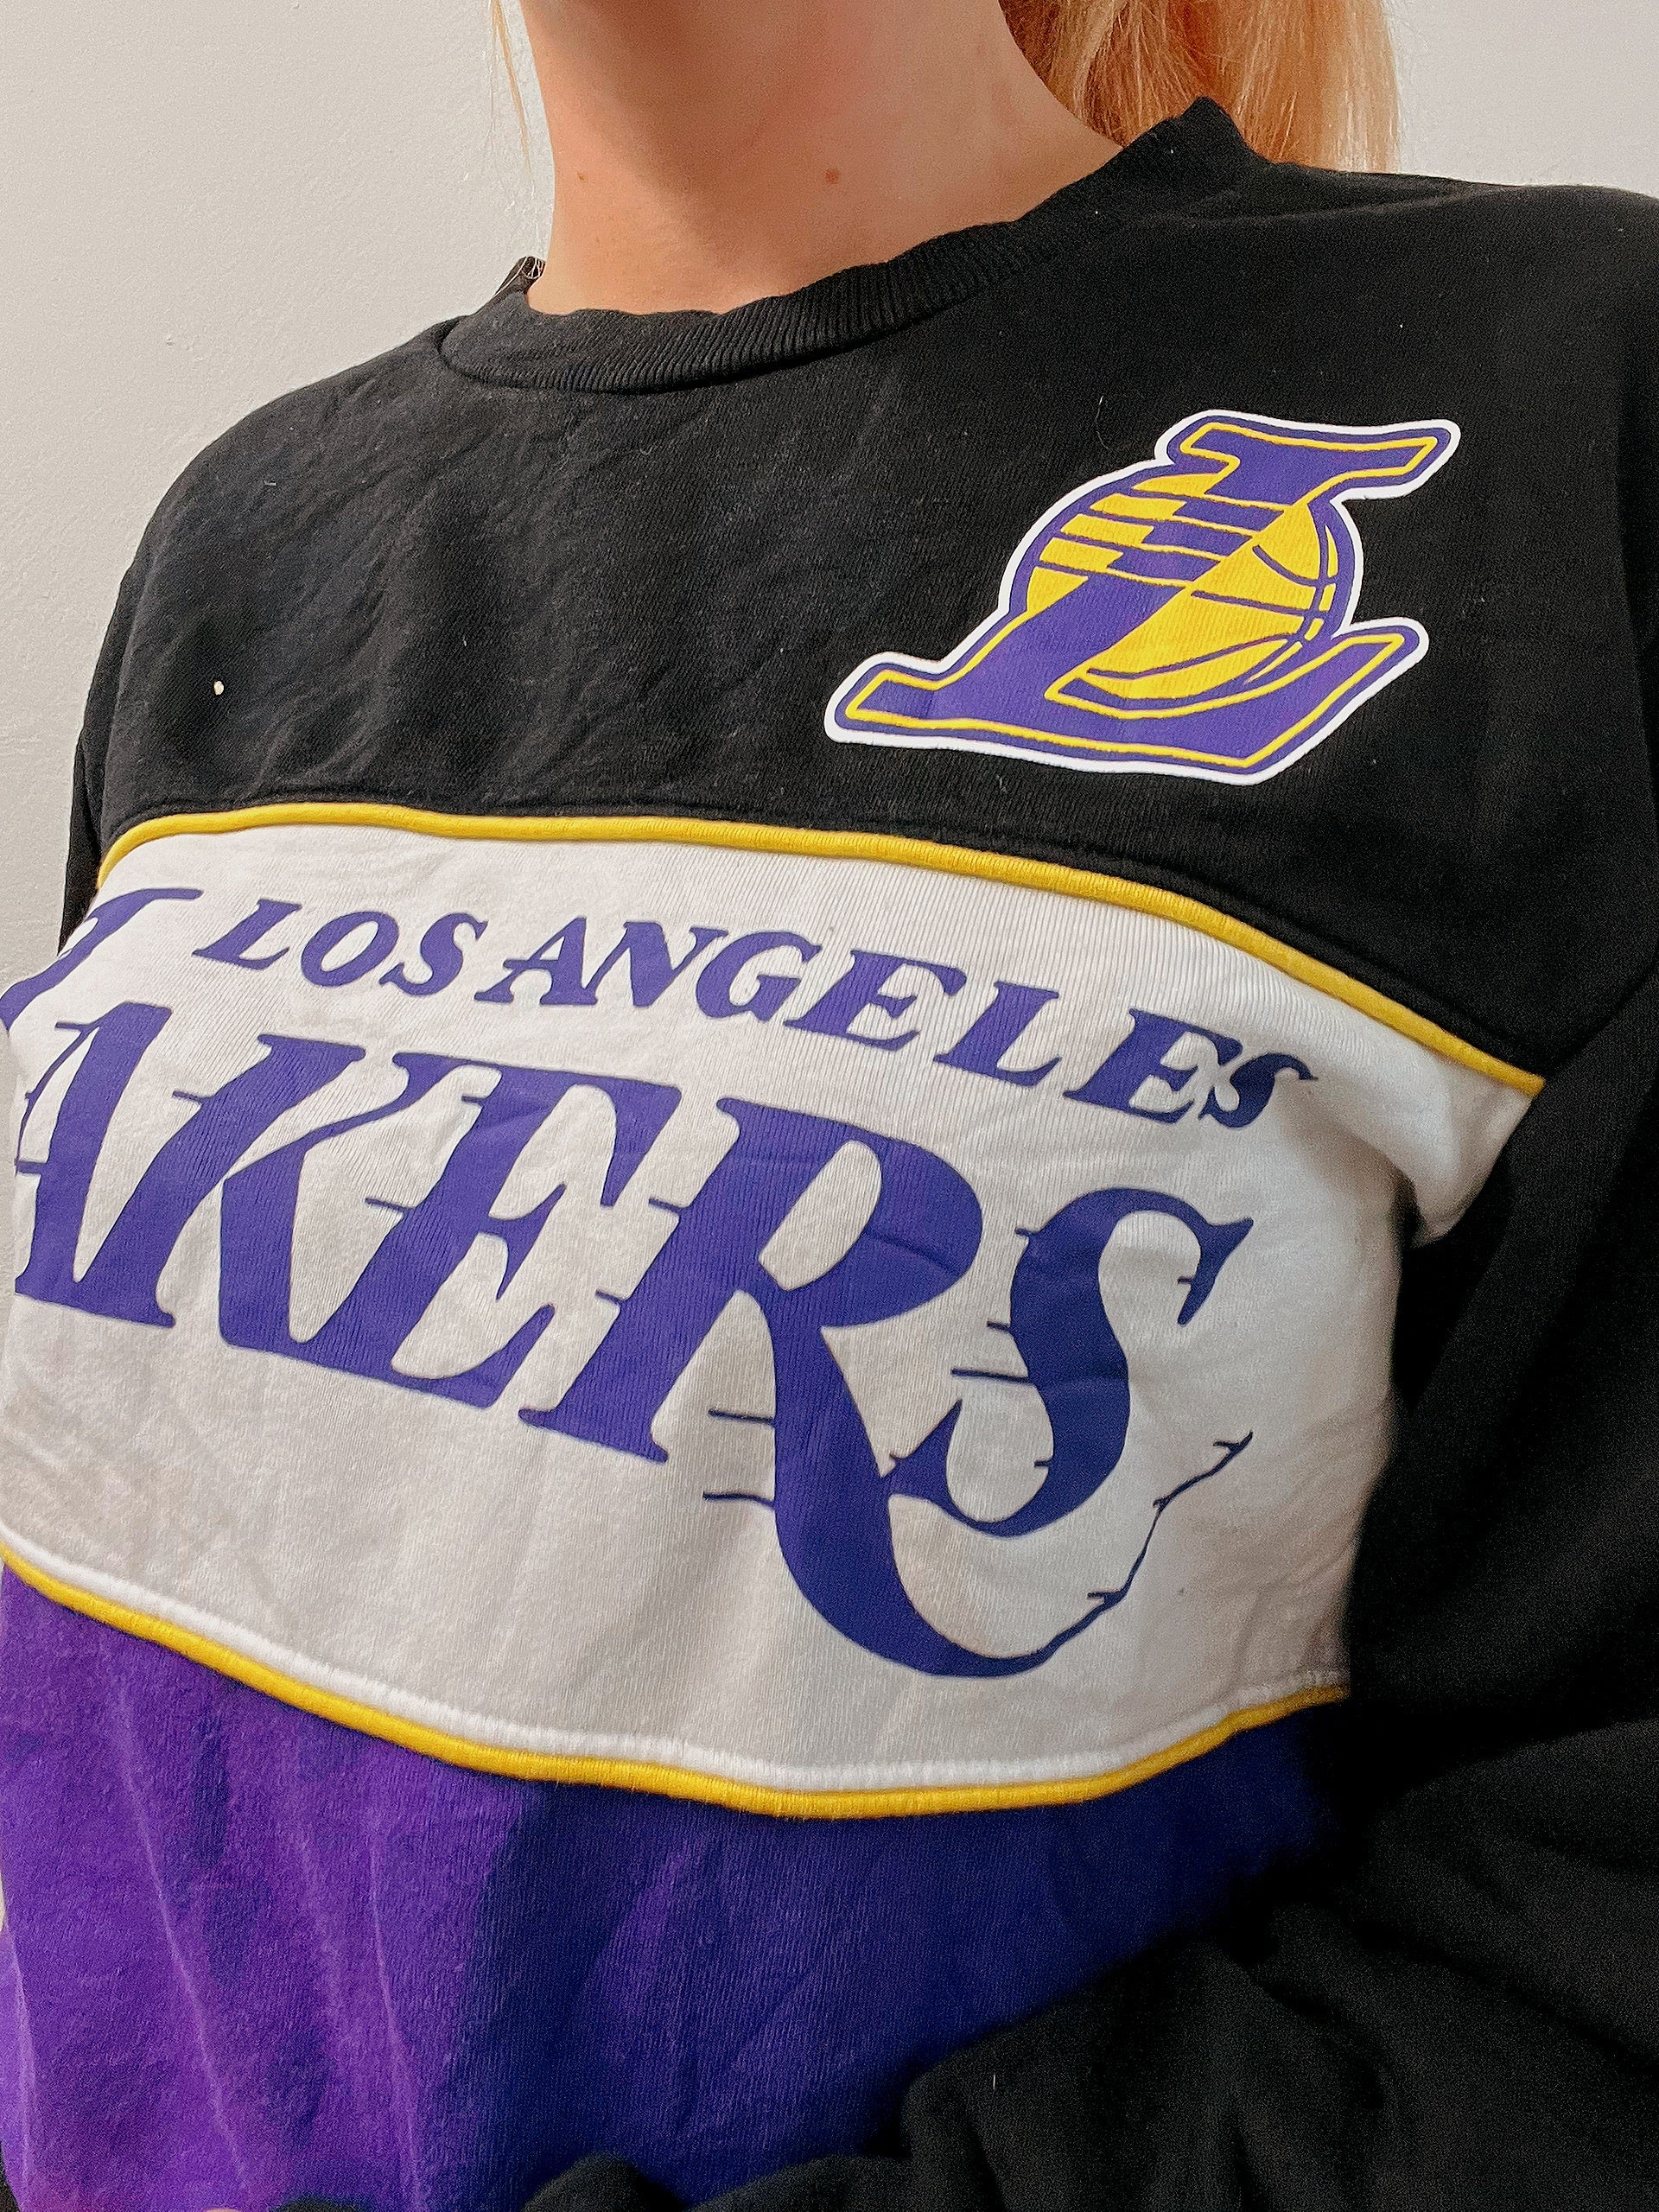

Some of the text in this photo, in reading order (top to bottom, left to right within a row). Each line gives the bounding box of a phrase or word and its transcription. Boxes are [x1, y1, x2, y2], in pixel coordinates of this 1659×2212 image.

[828, 411, 1459, 784] L
[192, 899, 1316, 1130] LOS ANGELES
